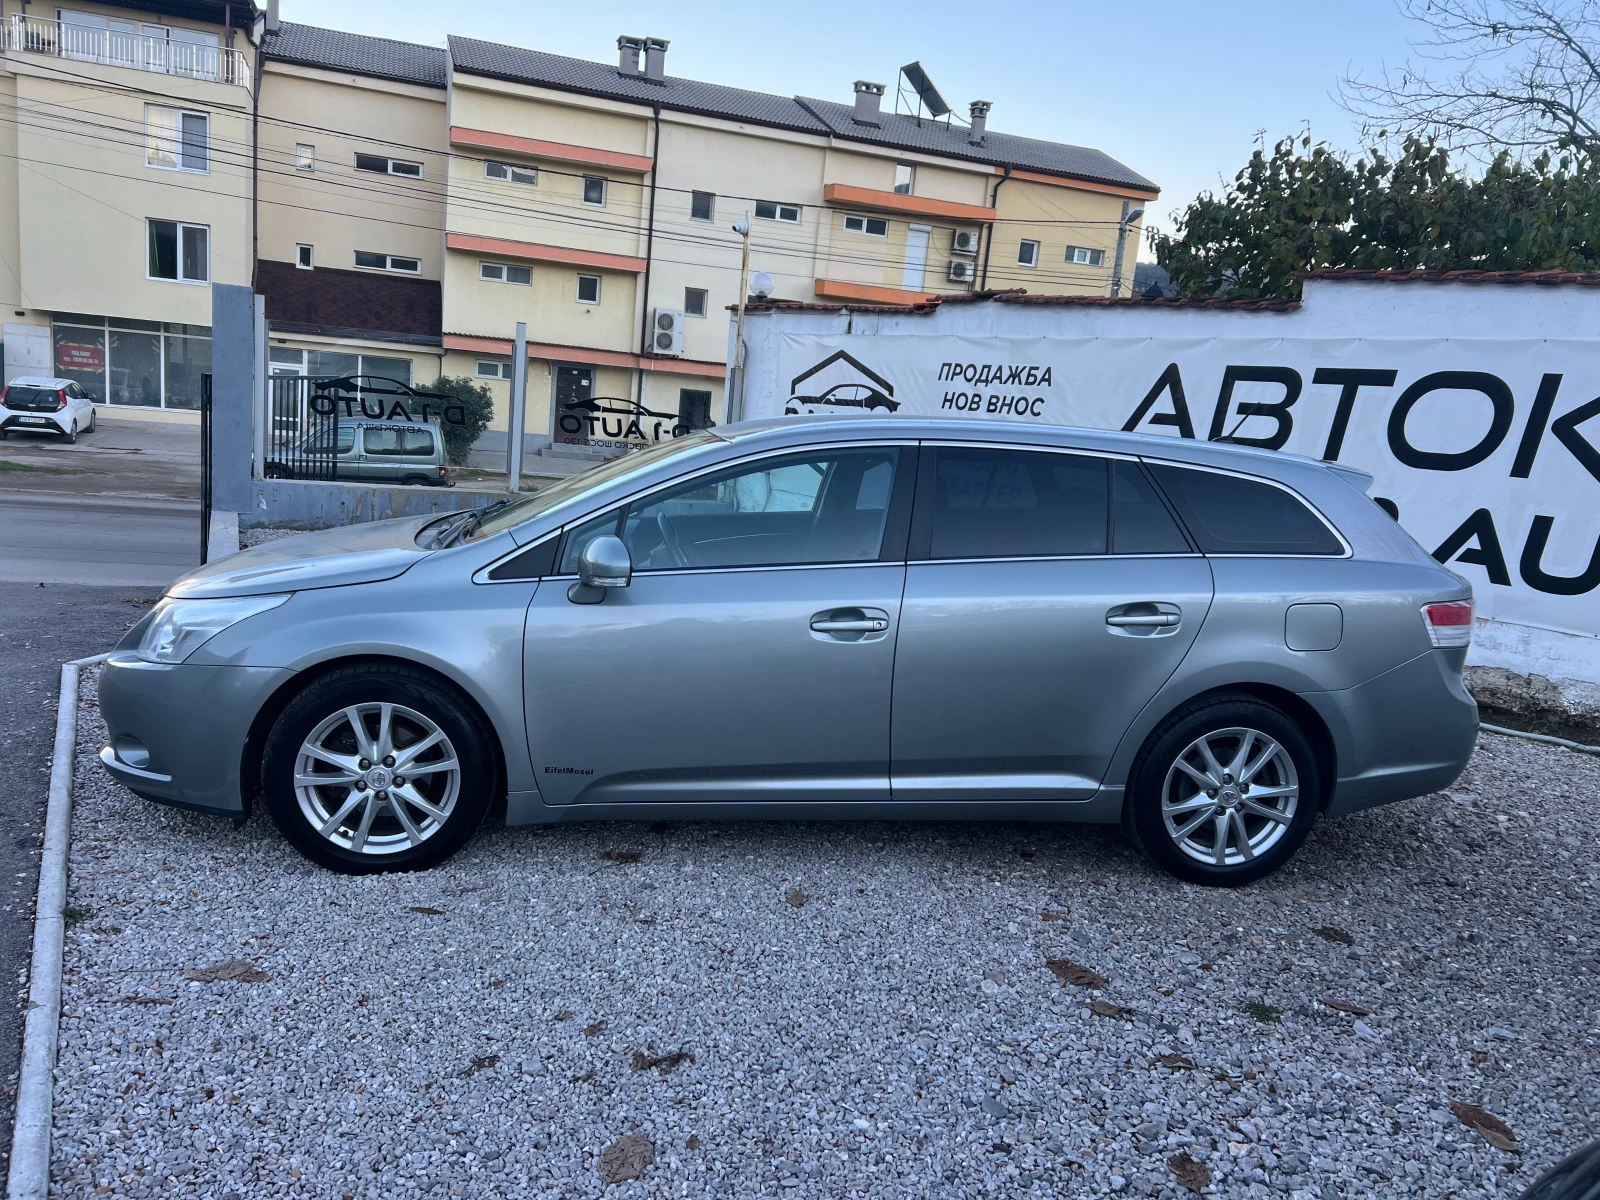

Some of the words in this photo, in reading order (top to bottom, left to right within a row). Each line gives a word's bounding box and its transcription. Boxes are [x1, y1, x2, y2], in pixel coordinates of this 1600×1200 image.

[937, 362, 1052, 387] ПРОДАЖБА
[941, 392, 981, 412] НОВ
[986, 394, 1046, 417] ВНОС
[544, 766, 594, 776] EifelMosel
